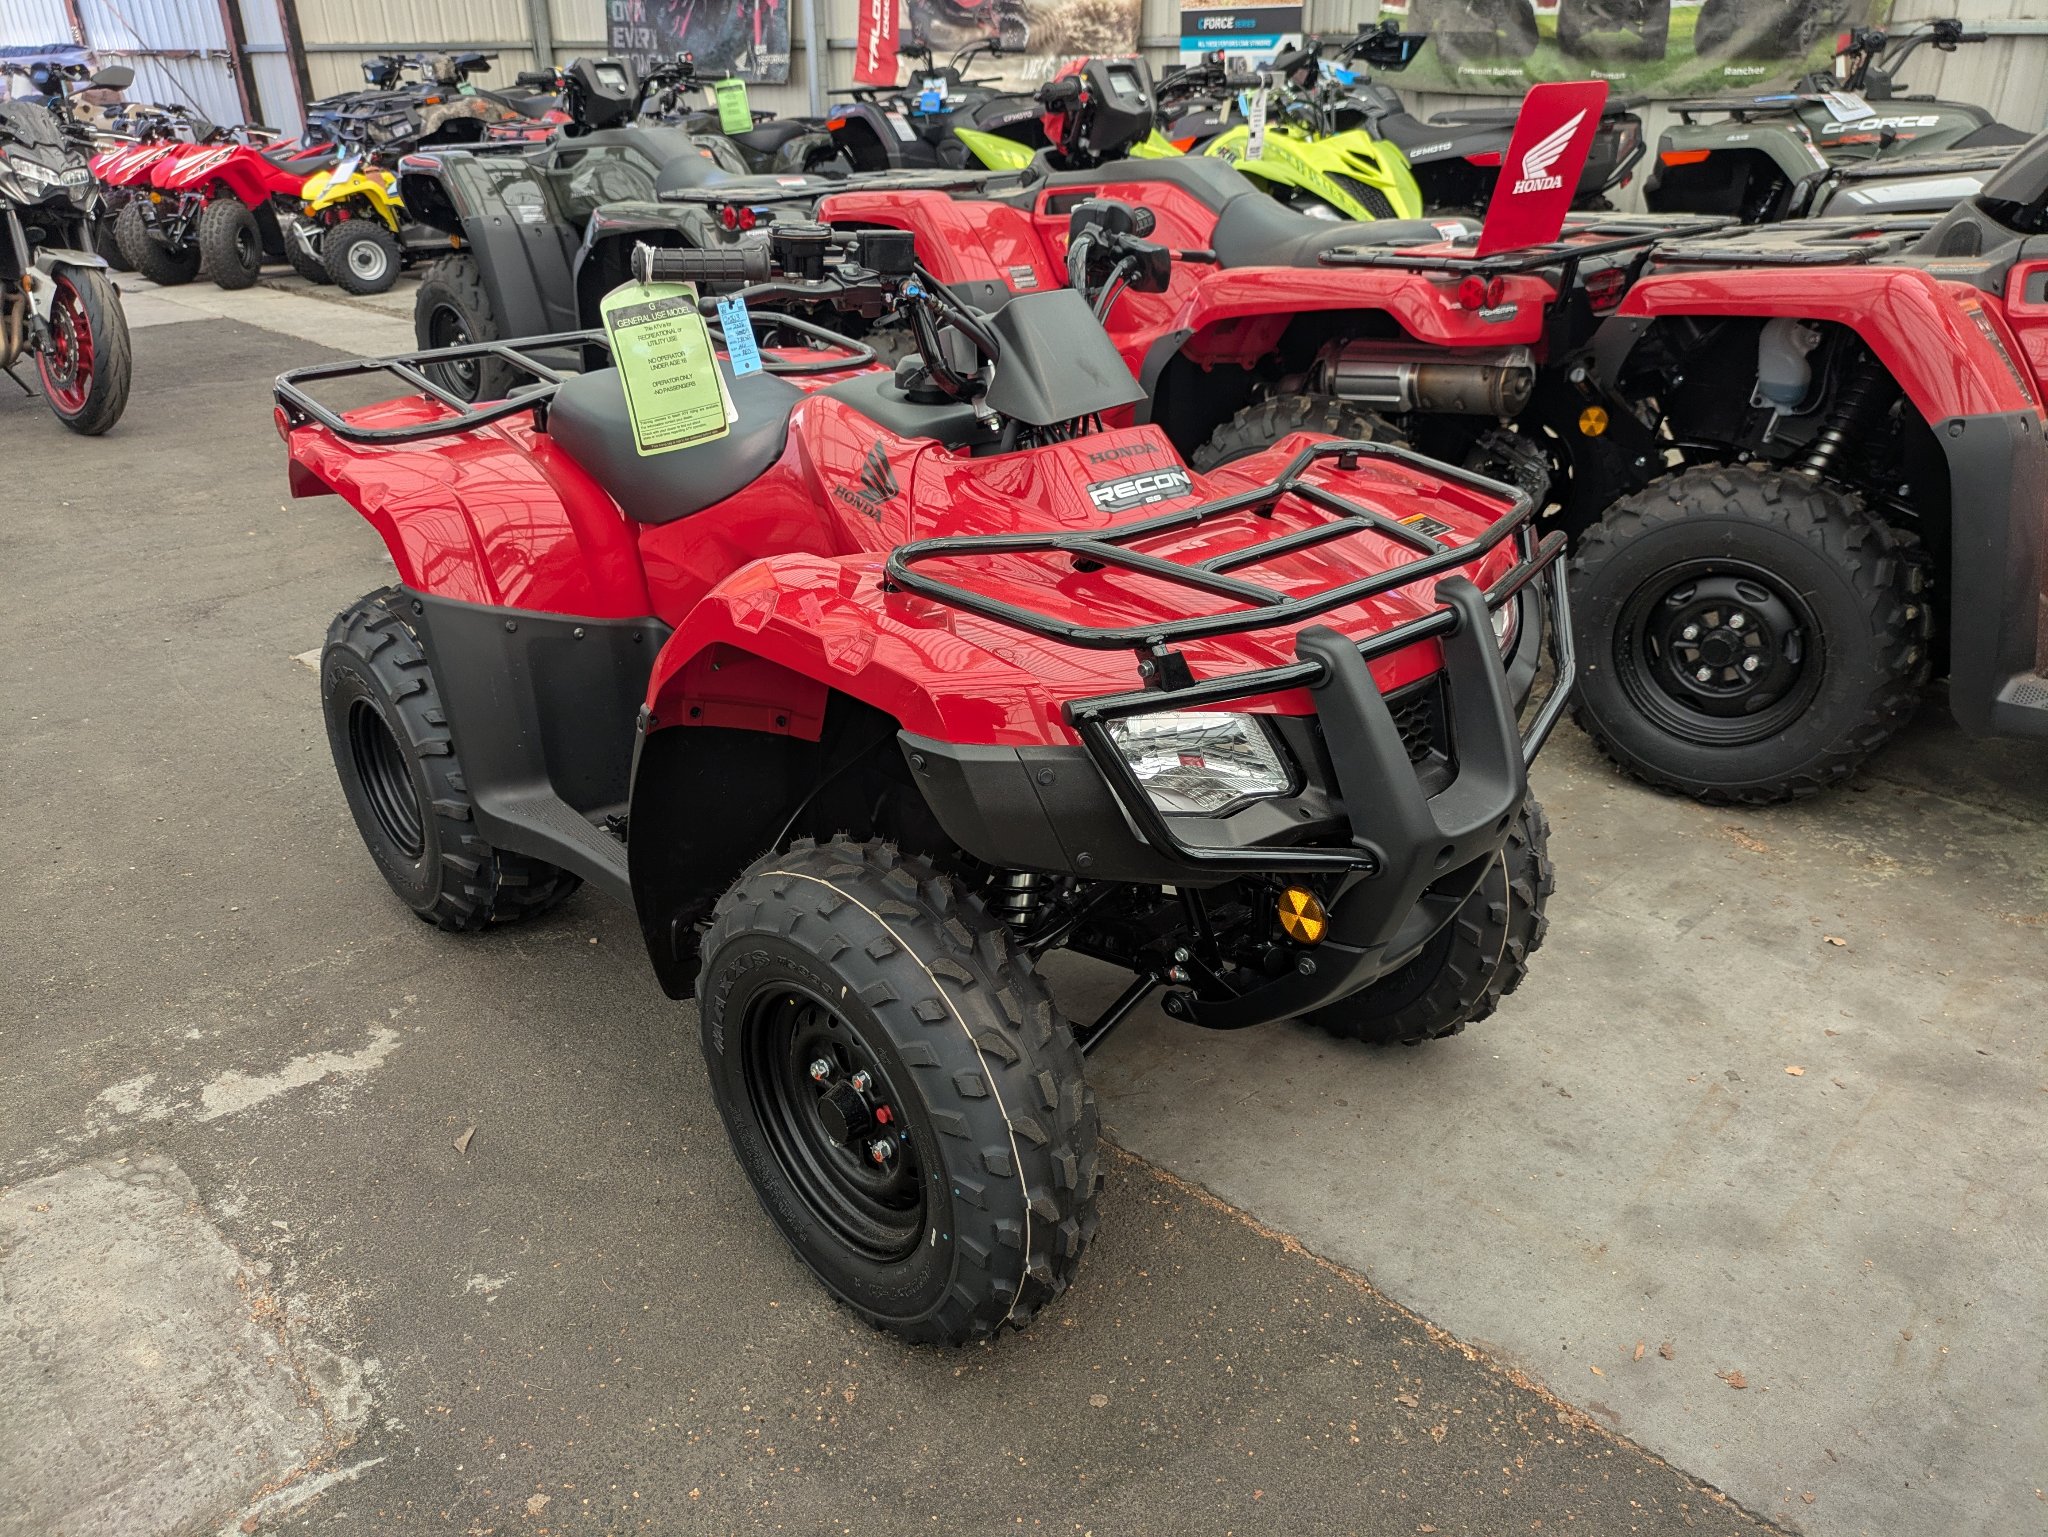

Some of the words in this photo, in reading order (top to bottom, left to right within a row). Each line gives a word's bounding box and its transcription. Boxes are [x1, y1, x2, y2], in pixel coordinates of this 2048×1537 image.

[1724, 66, 1766, 77] Rancher
[1821, 115, 1940, 134] CFORCE
[1409, 141, 1453, 158] CFMOTO
[1511, 175, 1563, 195] HONDA
[648, 302, 656, 311] G
[617, 314, 652, 328] GENERAL
[652, 310, 666, 321] USE
[667, 306, 692, 317] MODEL
[637, 329, 677, 342] RECREATIONAL
[647, 338, 667, 347] UTILITY
[647, 357, 656, 365] NO
[656, 350, 686, 362] OPERATOR
[650, 361, 669, 371] UNDER
[669, 358, 680, 366] AGE
[652, 376, 680, 388] OPERATOR
[663, 381, 697, 393] PASSENGERS
[1087, 443, 1159, 465] HONDA
[1089, 470, 1192, 506] RECON
[834, 483, 882, 524] HONDA
[711, 949, 771, 1057] MAXXIS
